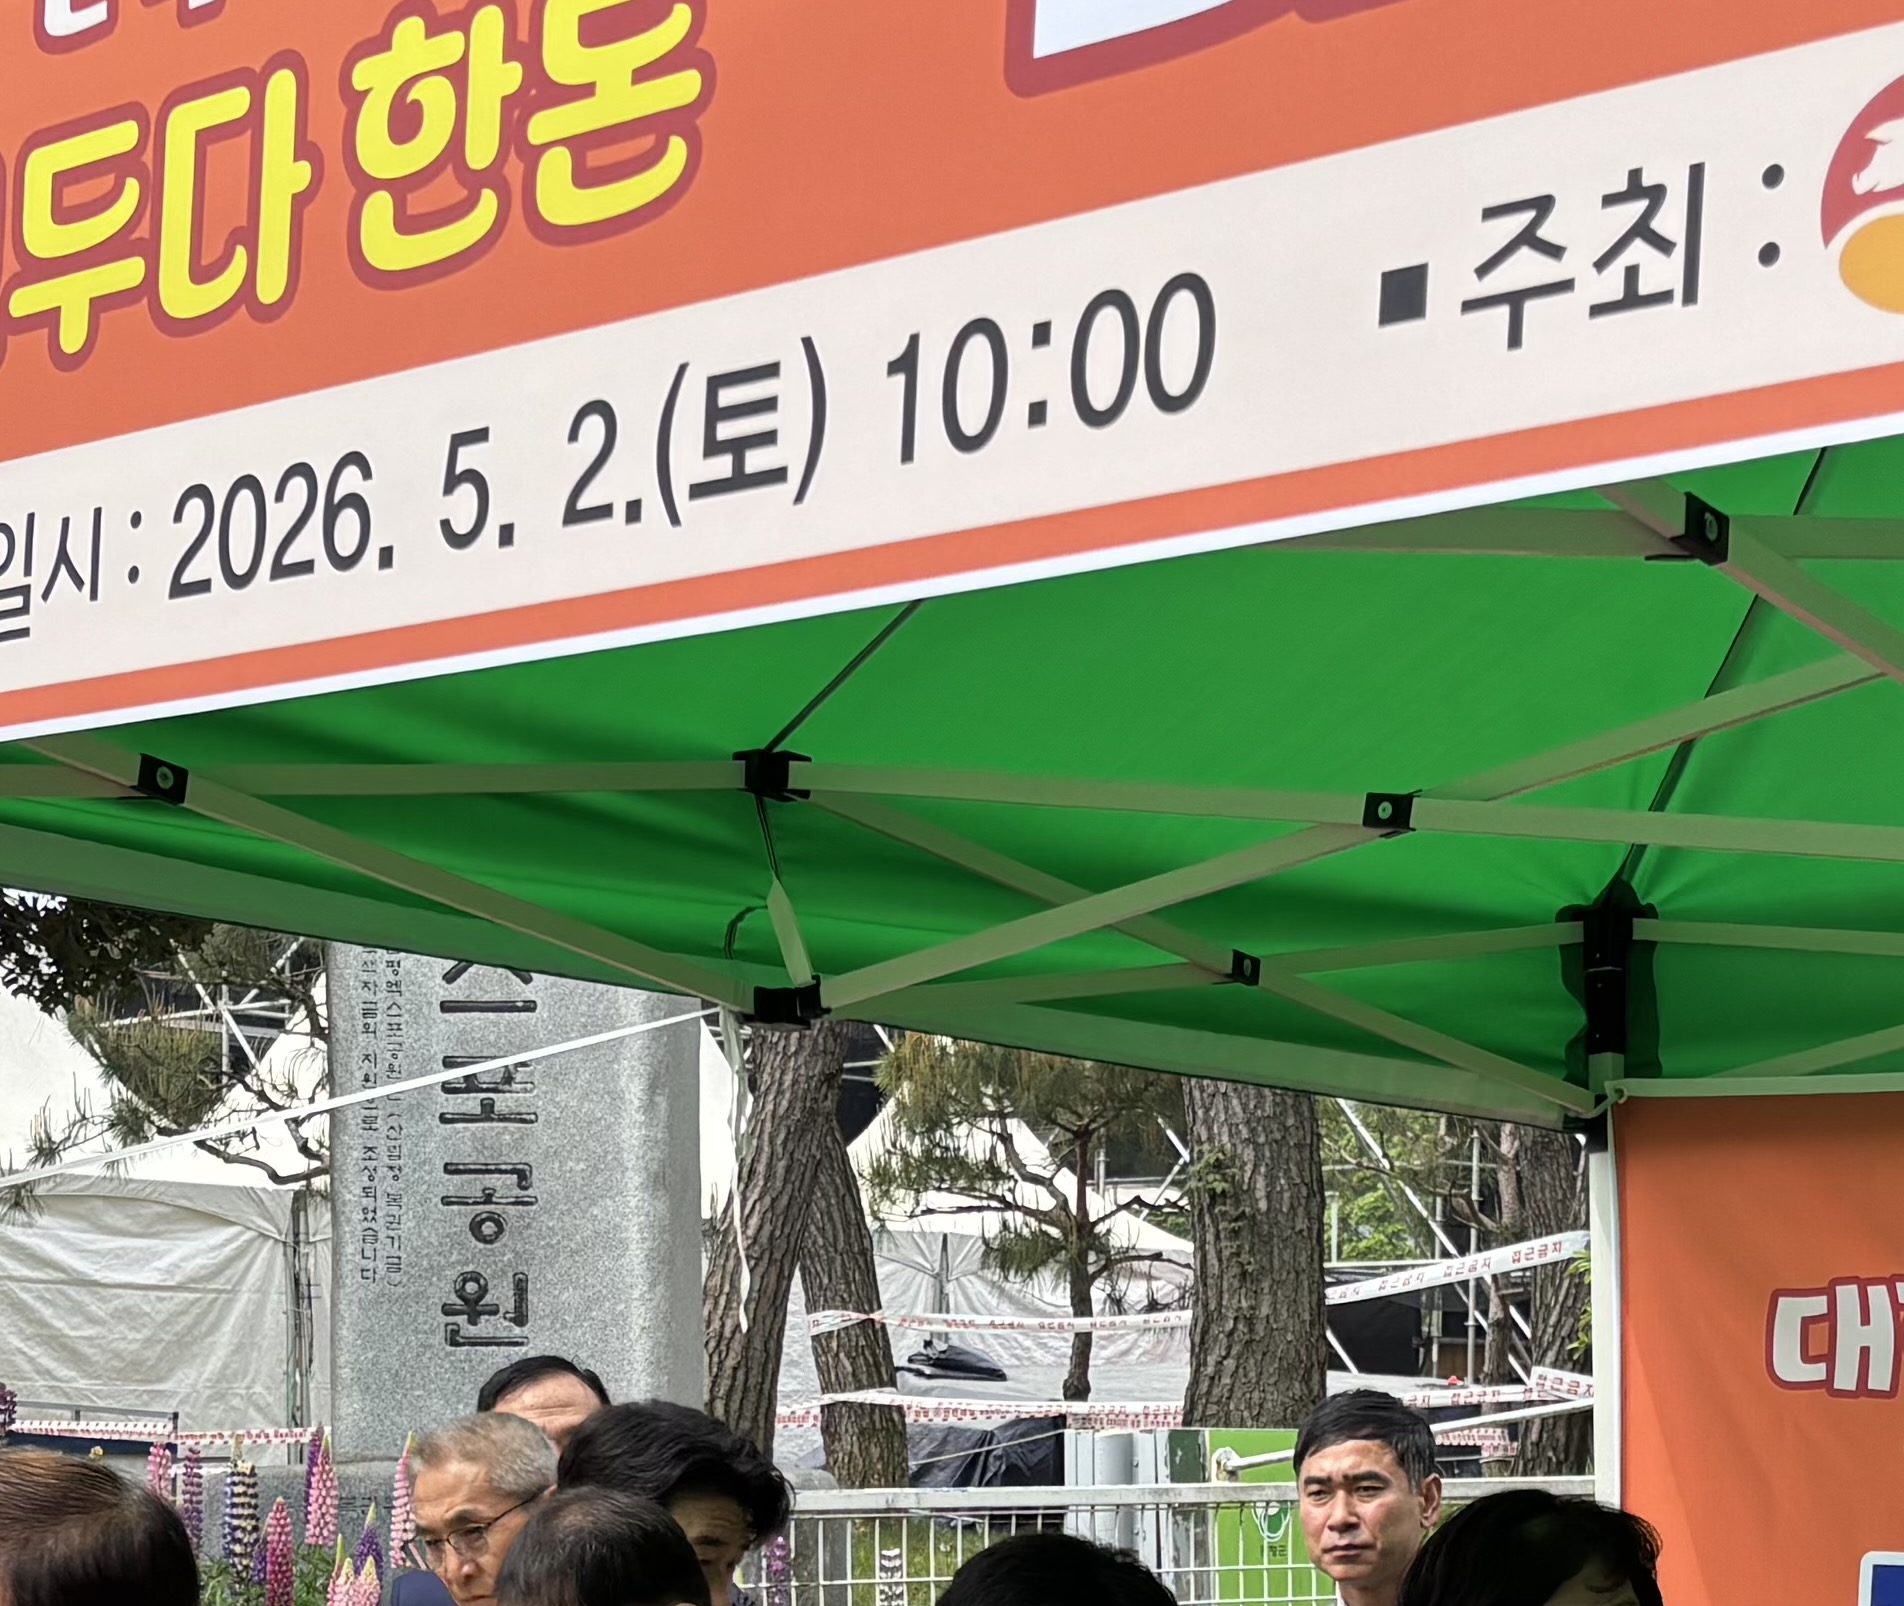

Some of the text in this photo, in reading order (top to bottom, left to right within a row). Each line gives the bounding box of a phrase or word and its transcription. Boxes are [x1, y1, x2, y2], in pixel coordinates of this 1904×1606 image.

[352, 0, 702, 271] 한돈
[1460, 161, 1706, 352] 주최
[168, 450, 395, 601] 2026.
[438, 425, 516, 552] 5.
[886, 272, 1217, 467] 10:00
